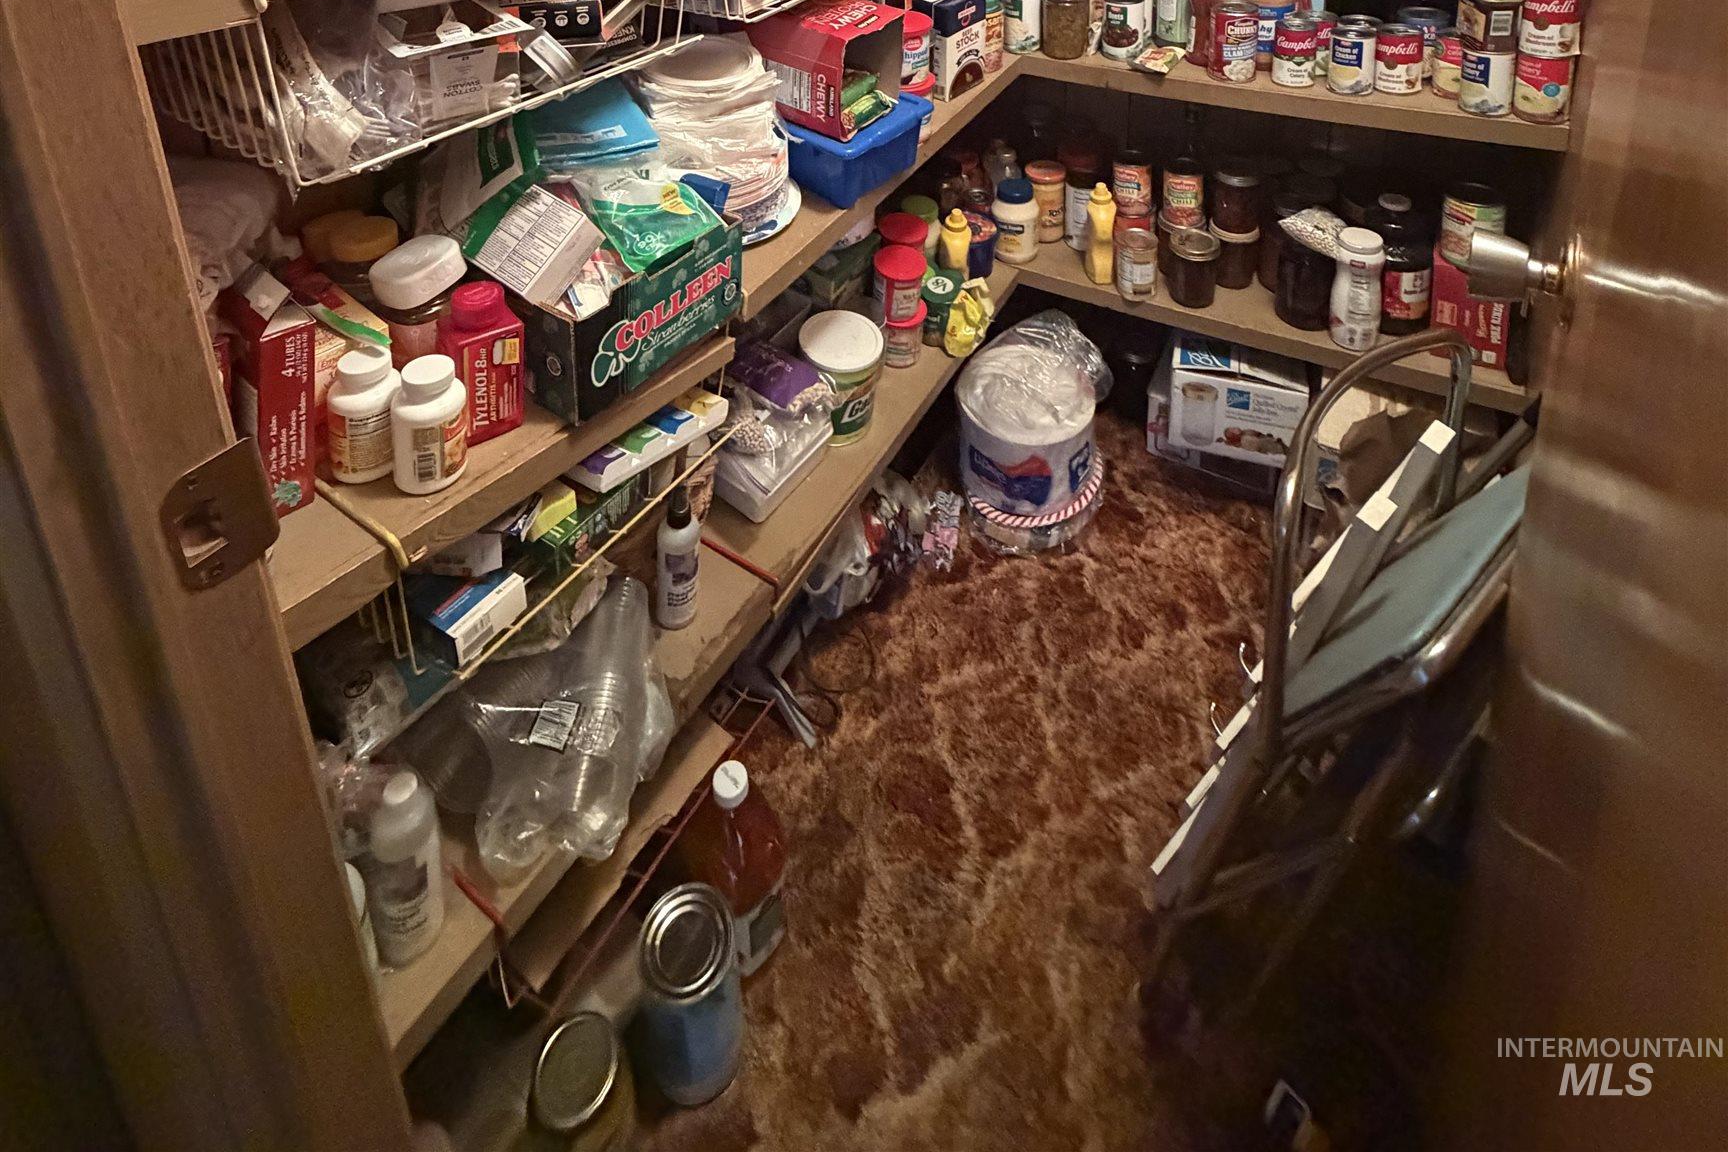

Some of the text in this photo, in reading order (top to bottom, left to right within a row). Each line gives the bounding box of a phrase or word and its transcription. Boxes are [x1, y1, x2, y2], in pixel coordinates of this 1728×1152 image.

[830, 5, 877, 30] CHEWY
[1524, 0, 1575, 14] ampbell's
[956, 31, 980, 49] STOCK
[1379, 43, 1418, 56] ampbell's
[444, 85, 483, 98] COTTON
[446, 79, 481, 89] SWABS
[817, 74, 826, 122] CHEWY
[615, 255, 732, 351] COLLEEN
[642, 295, 715, 351] Strawberries
[285, 335, 295, 367] TUBES
[472, 369, 489, 431] TYLENOL
